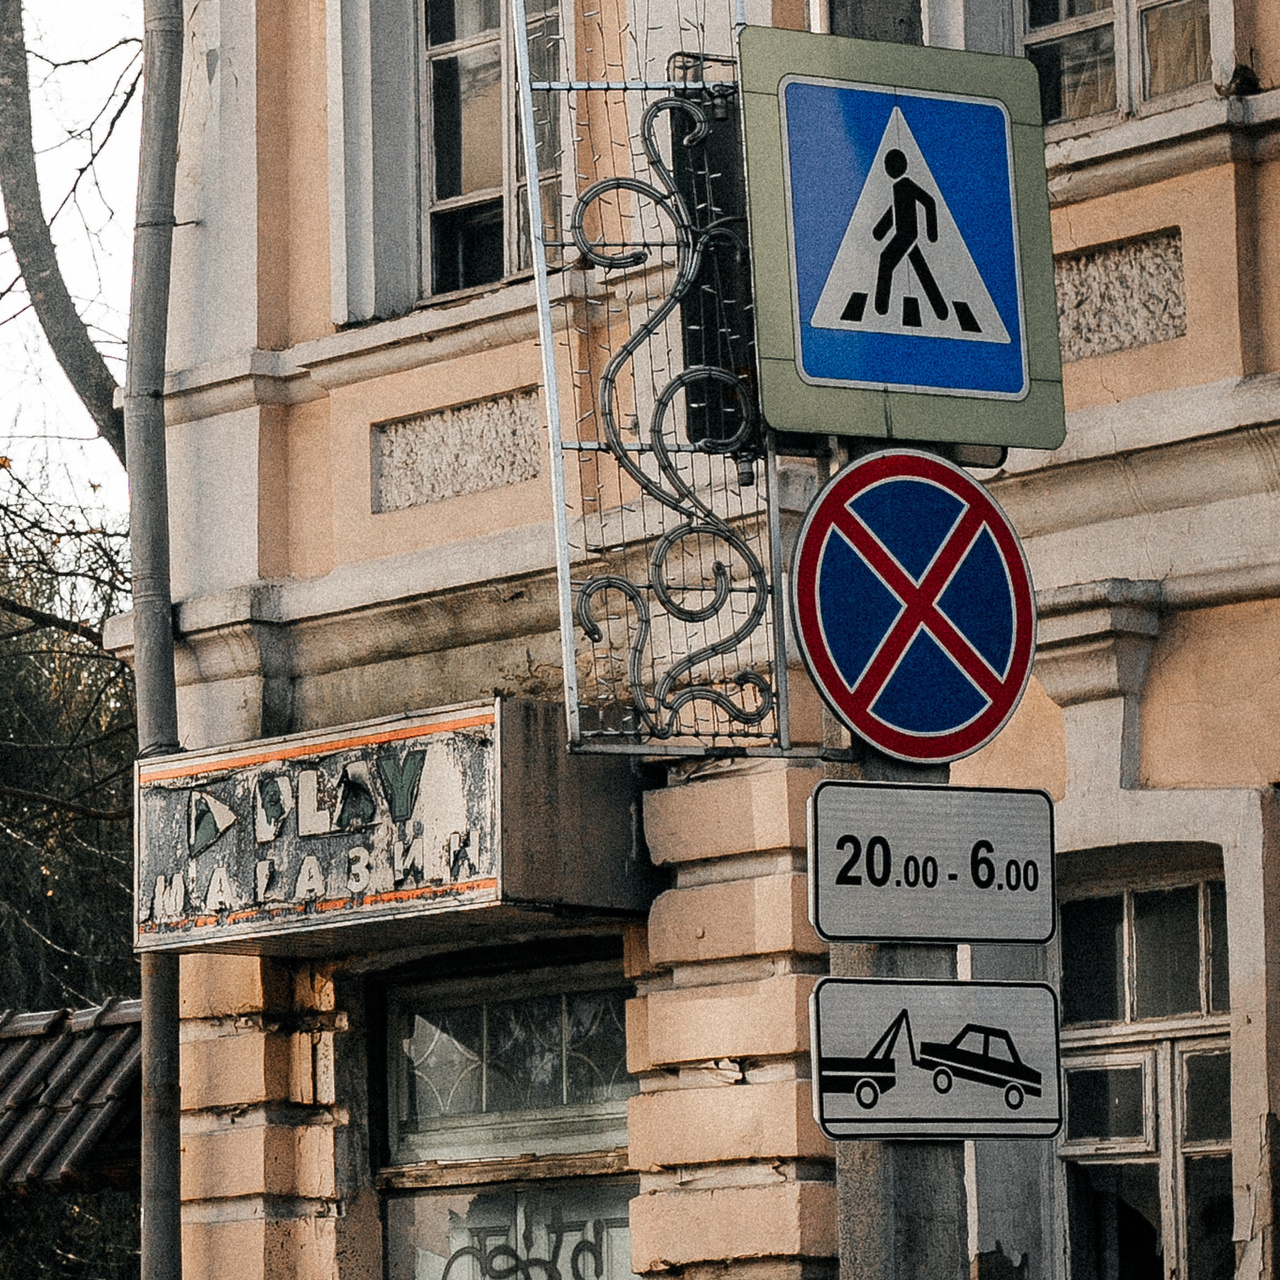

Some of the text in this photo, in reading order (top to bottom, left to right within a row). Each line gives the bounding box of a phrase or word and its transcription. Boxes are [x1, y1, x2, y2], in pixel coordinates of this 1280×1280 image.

[152, 829, 481, 924] МАГАЗИН
[835, 834, 939, 889] 20.00
[970, 839, 1039, 892] 6.00
